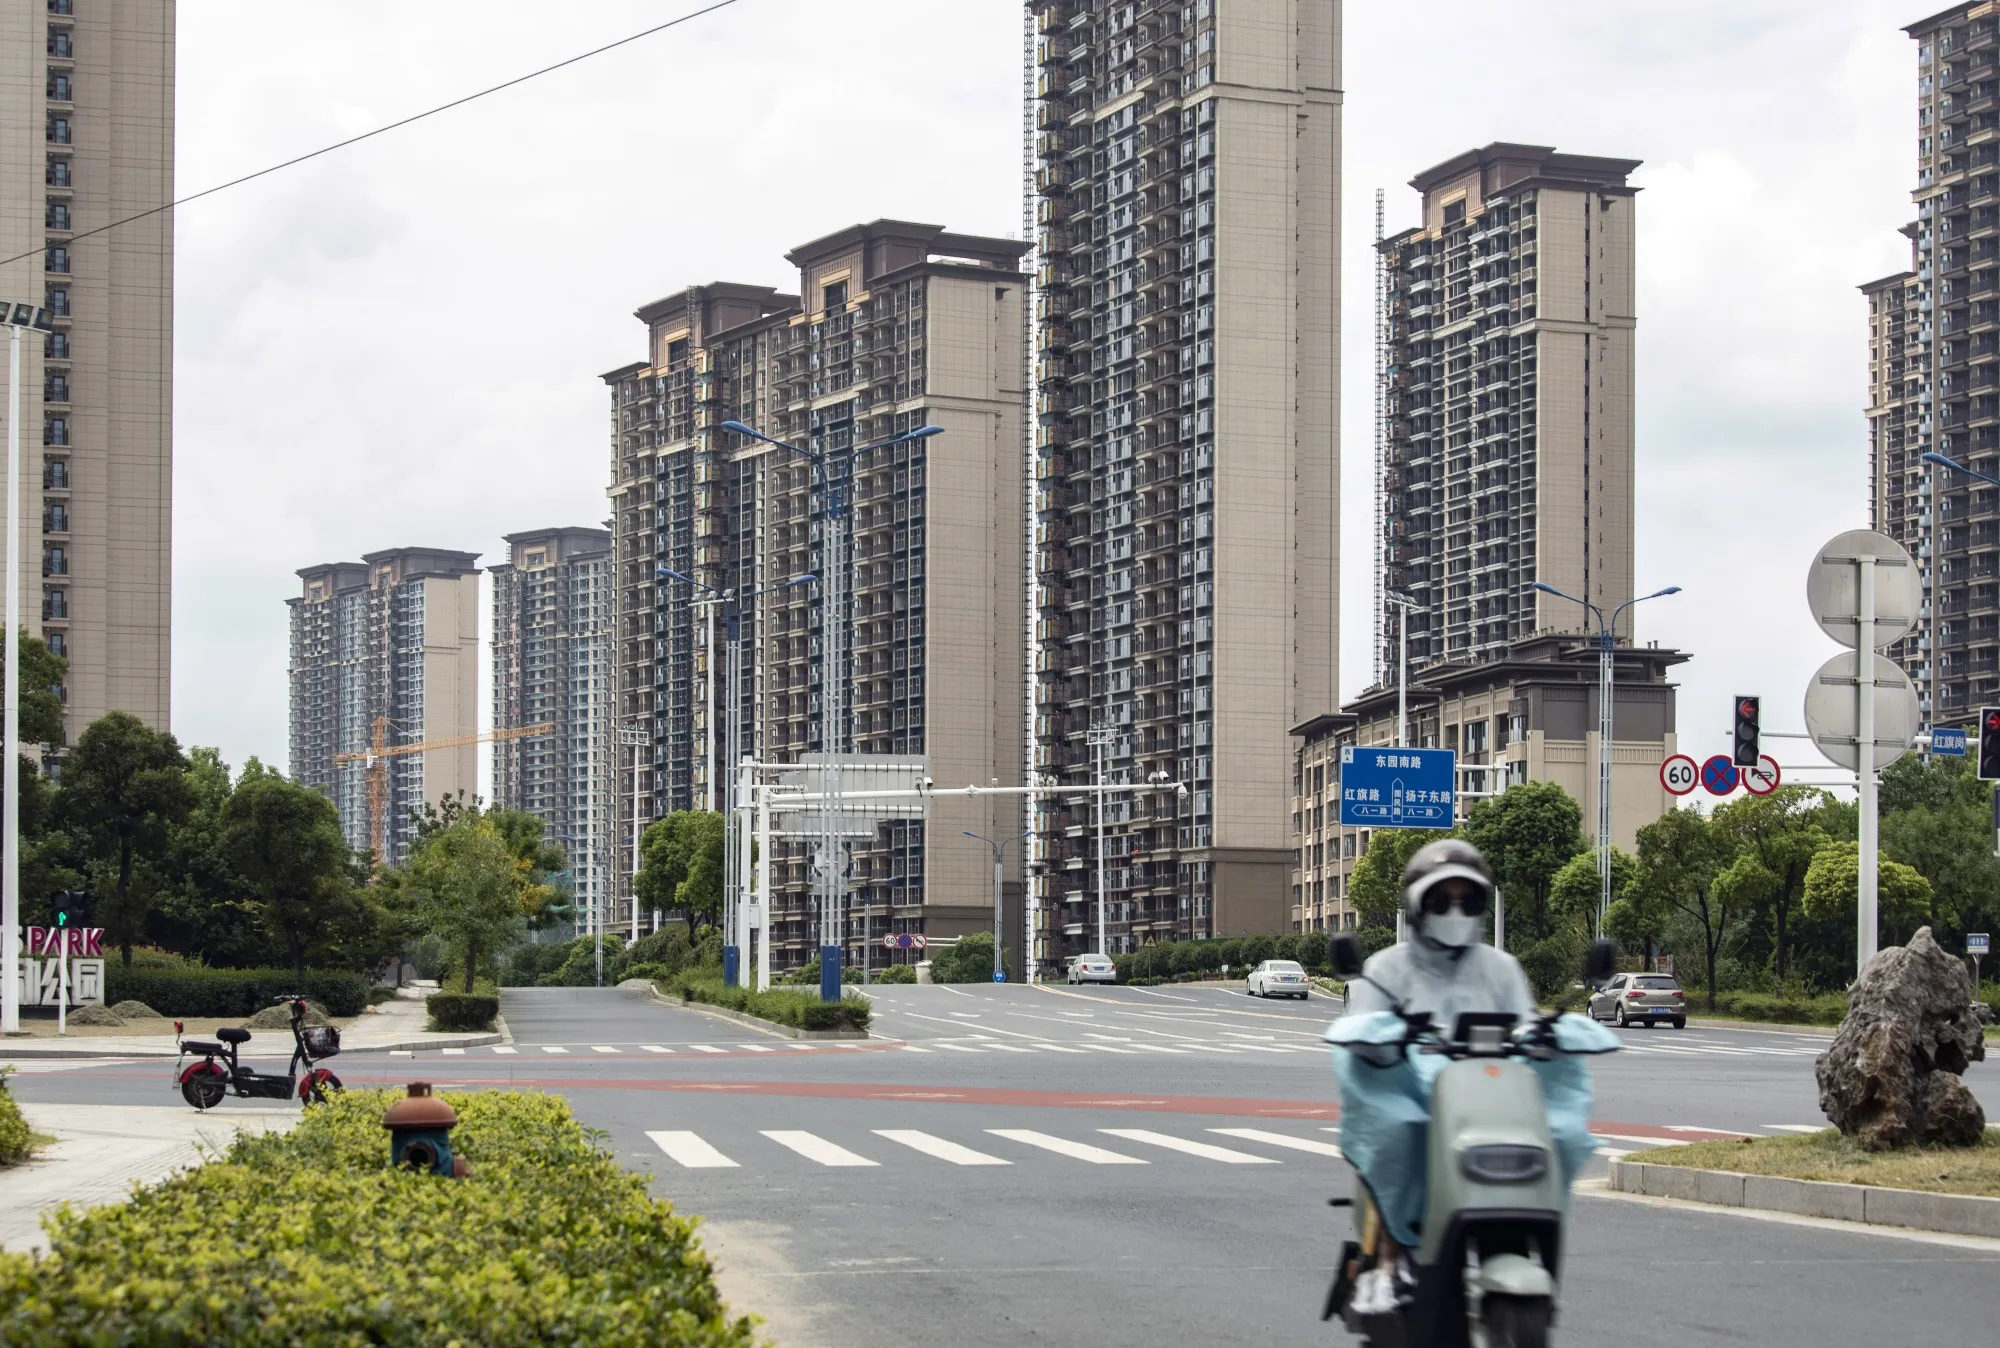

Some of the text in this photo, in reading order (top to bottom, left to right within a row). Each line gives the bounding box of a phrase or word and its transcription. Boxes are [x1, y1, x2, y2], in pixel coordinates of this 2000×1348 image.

[1933, 734, 1965, 749] 红旗岗
[1375, 755, 1421, 768] 东园南路
[1669, 766, 1692, 784] 60
[1344, 788, 1380, 801] 红旗路
[1405, 790, 1451, 803] 扬子东路
[1361, 806, 1388, 815] 八一路
[1407, 808, 1434, 817] 八一路
[27, 926, 105, 956] PARK
[886, 937, 895, 945] 60
